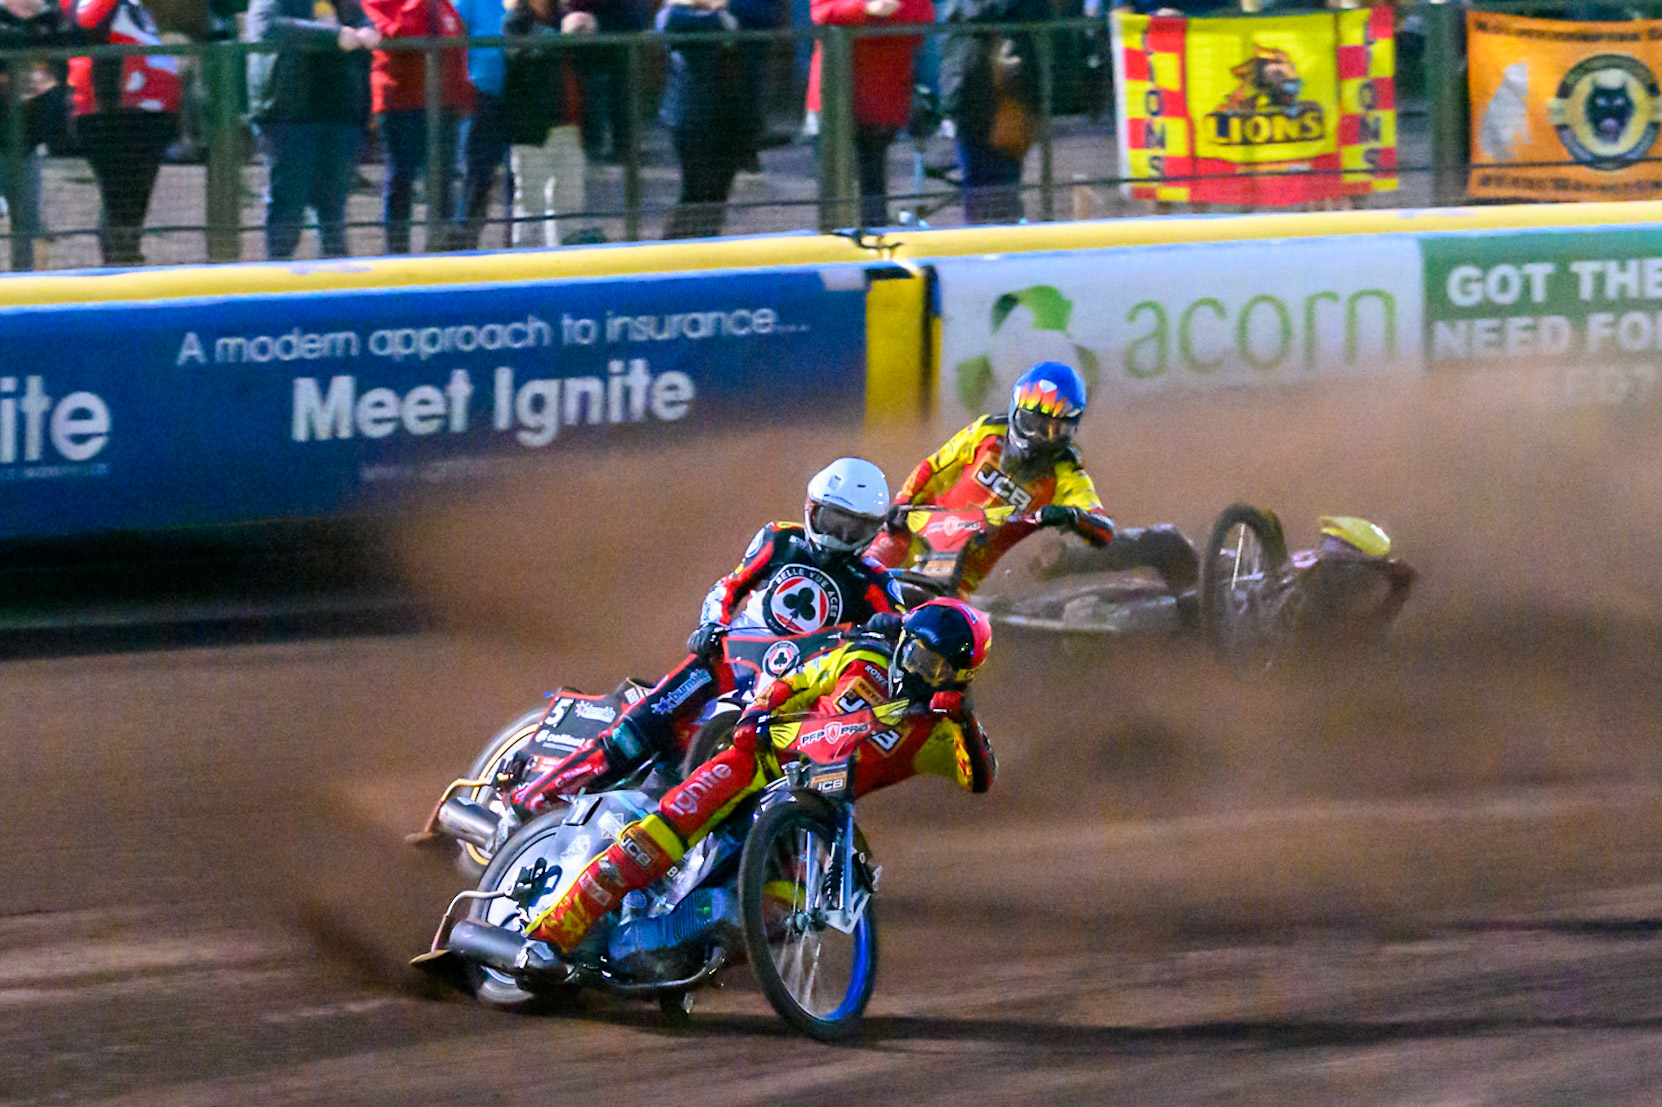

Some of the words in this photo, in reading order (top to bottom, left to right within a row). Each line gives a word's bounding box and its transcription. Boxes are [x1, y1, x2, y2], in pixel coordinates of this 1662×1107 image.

[1206, 109, 1325, 145] LIONS
[1447, 263, 1556, 307] GOT
[176, 331, 207, 366] A
[214, 327, 361, 363] modern
[368, 314, 552, 362] approach
[561, 312, 597, 346] to
[1124, 288, 1398, 380] acorn
[1431, 315, 1571, 361] NEED
[1587, 310, 1662, 353] FO
[292, 368, 473, 442] Meet
[493, 357, 695, 447] Ignite
[976, 467, 1033, 511] JCB
[775, 567, 805, 585] BELLE
[809, 571, 831, 588] VUE
[827, 590, 839, 618] ACES
[544, 697, 575, 726] 5
[802, 730, 825, 746] PFP
[841, 722, 870, 736] PRO
[817, 778, 844, 791] JCB
[620, 837, 651, 867] JCB
